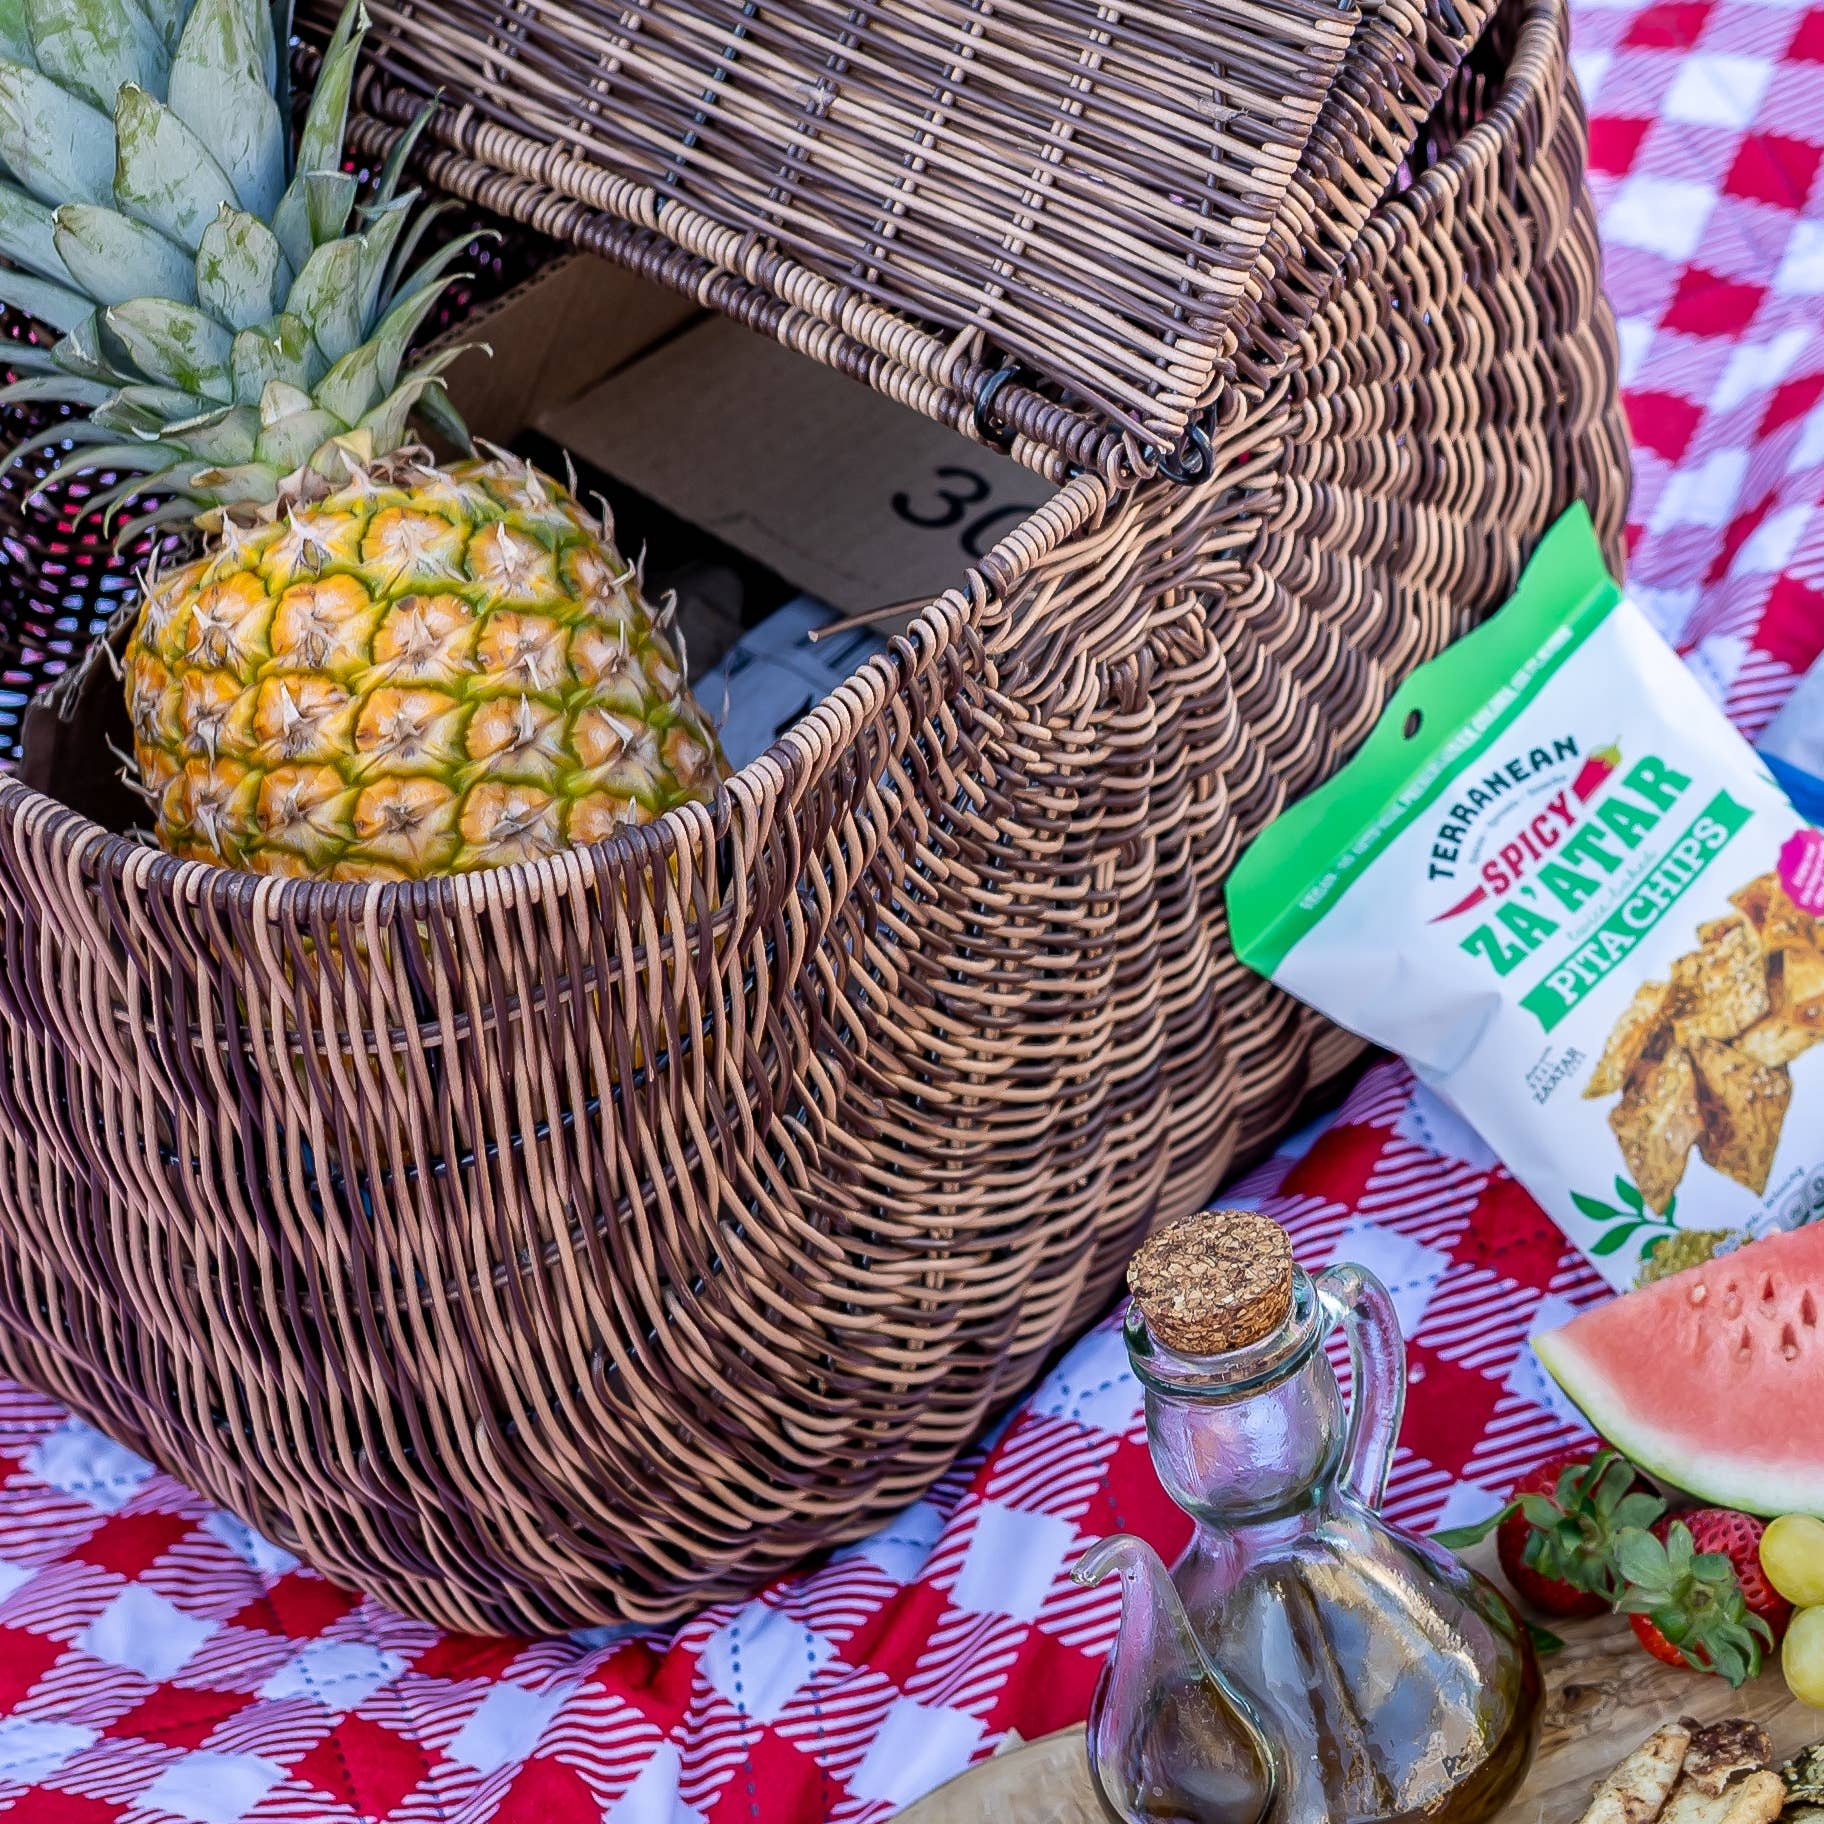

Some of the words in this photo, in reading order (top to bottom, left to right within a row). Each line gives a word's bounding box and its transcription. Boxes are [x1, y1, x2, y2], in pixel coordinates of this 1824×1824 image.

[1428, 736, 1579, 881] TERRANEAN
[1459, 755, 1692, 977] ZA'ATAR
[1481, 790, 1577, 895] SPICY
[1545, 929, 1636, 1007] PITA
[1622, 815, 1729, 929] CHIPS
